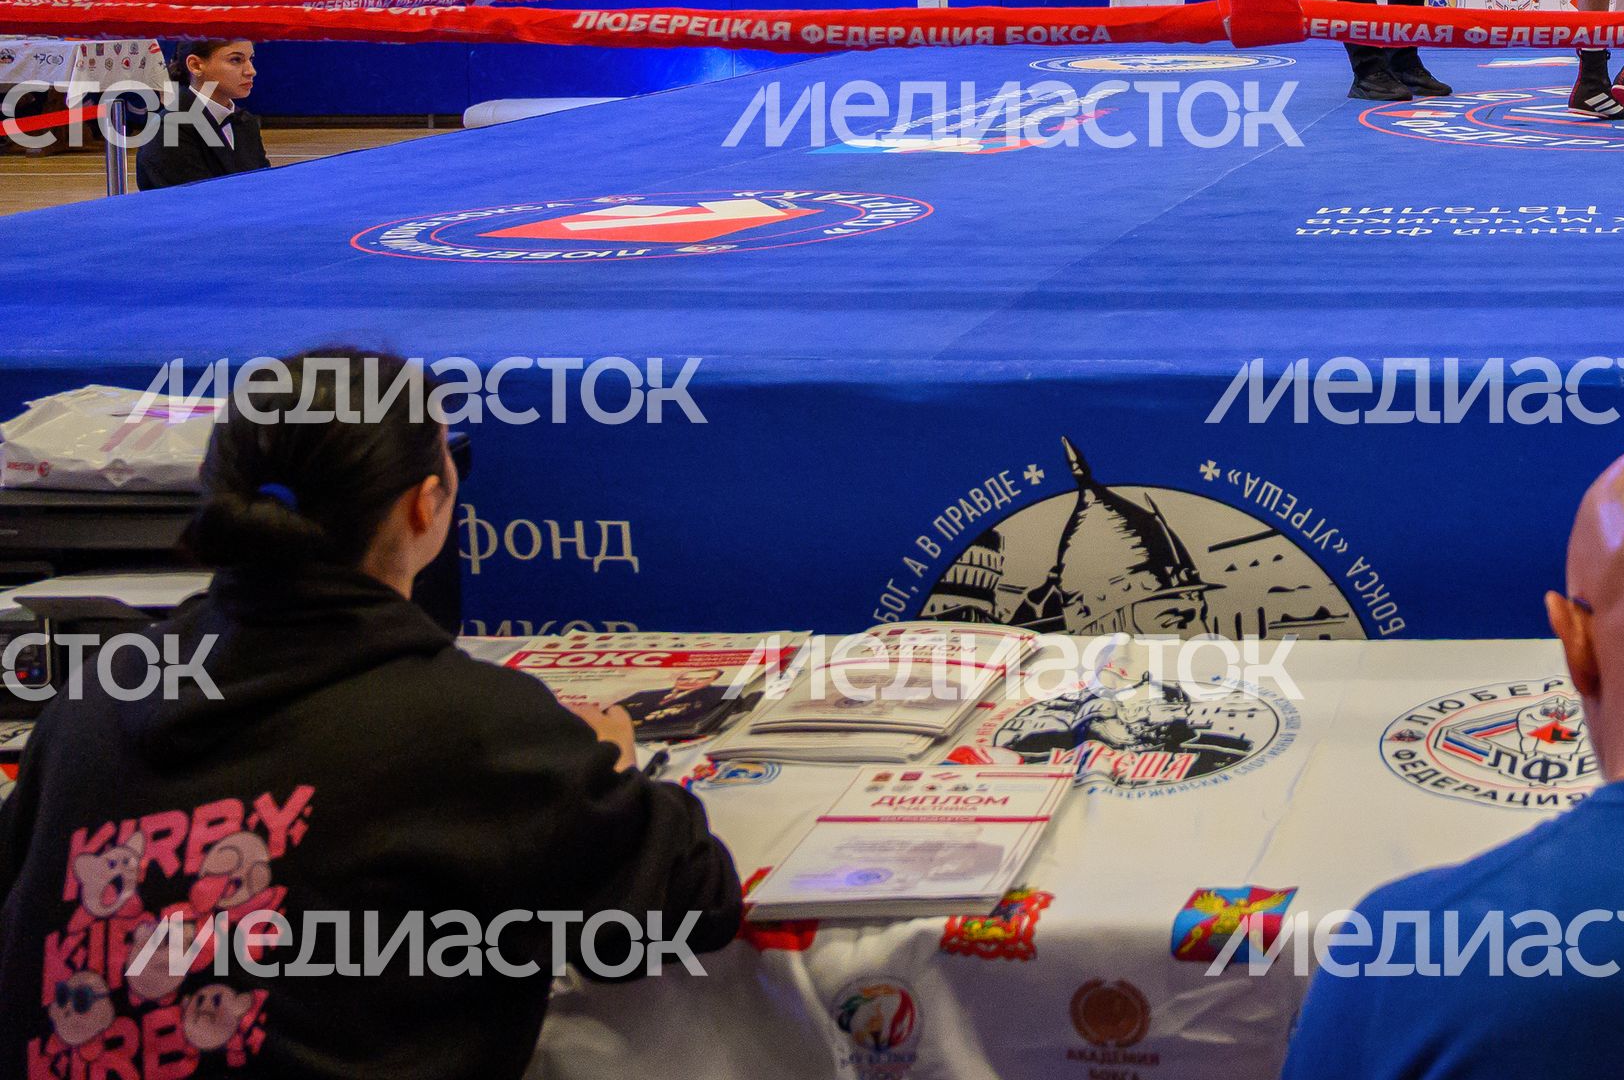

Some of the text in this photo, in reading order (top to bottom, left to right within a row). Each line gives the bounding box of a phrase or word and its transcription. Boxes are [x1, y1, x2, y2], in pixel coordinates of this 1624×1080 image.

[573, 10, 1112, 47] ЛЮБЕРЕЦКАЯ ФЕДЕРАЦИЯ БОКСА
[1315, 206, 1602, 215] Наталии
[1295, 227, 1433, 237] фонд
[903, 469, 1023, 577] А В ПРАВДЕ
[458, 503, 640, 574] фонд
[1344, 555, 1407, 638] БОКСА
[516, 650, 668, 670] БОКС
[870, 794, 1011, 808] ДИПЛОМ
